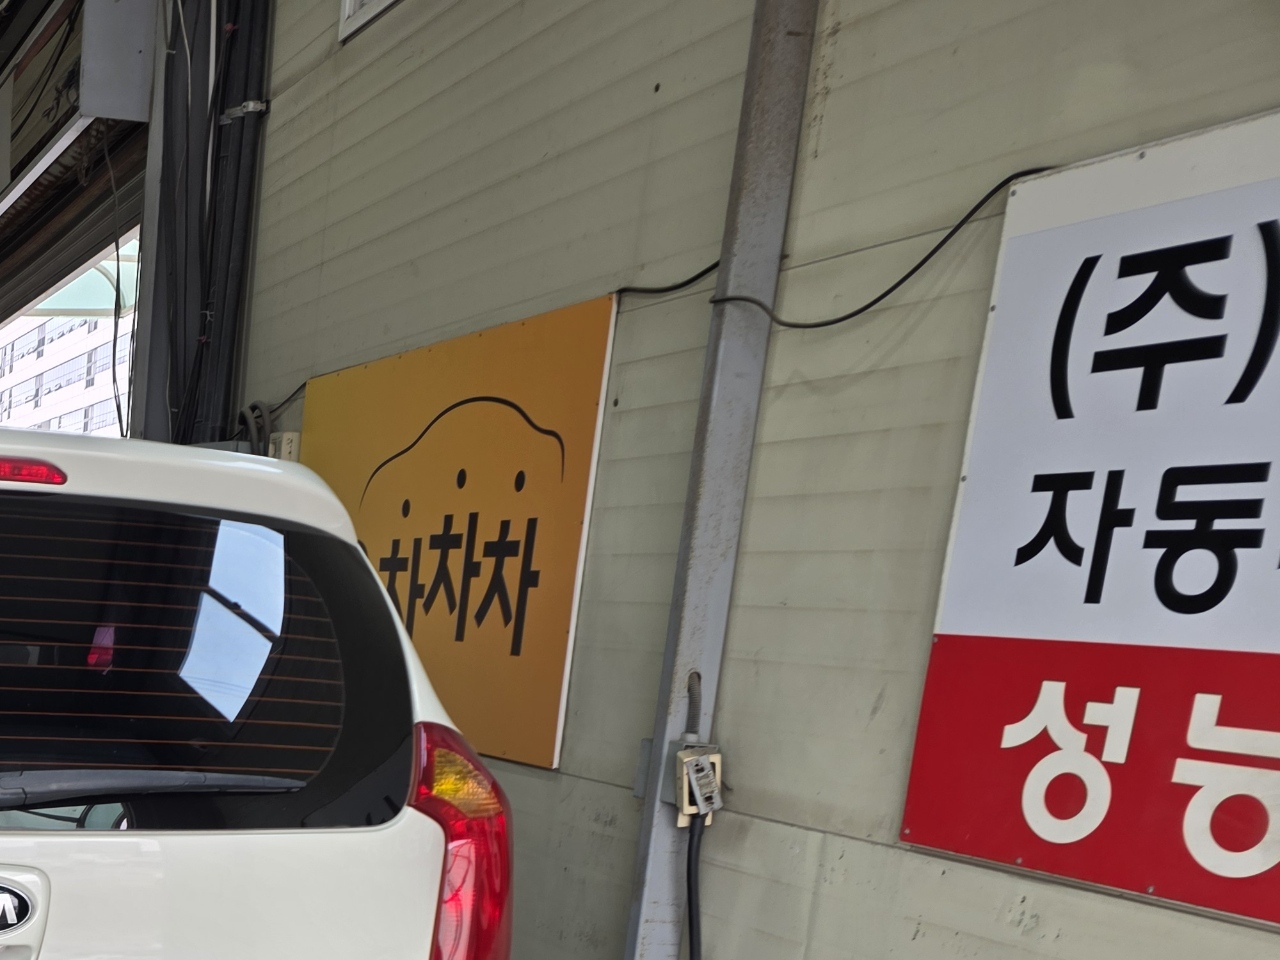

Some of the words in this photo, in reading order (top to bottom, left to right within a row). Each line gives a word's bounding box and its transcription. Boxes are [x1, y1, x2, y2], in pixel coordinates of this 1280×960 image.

[358, 511, 541, 657] 차차차
[1013, 461, 1280, 616] 자동
[1000, 680, 1280, 879] 성능
